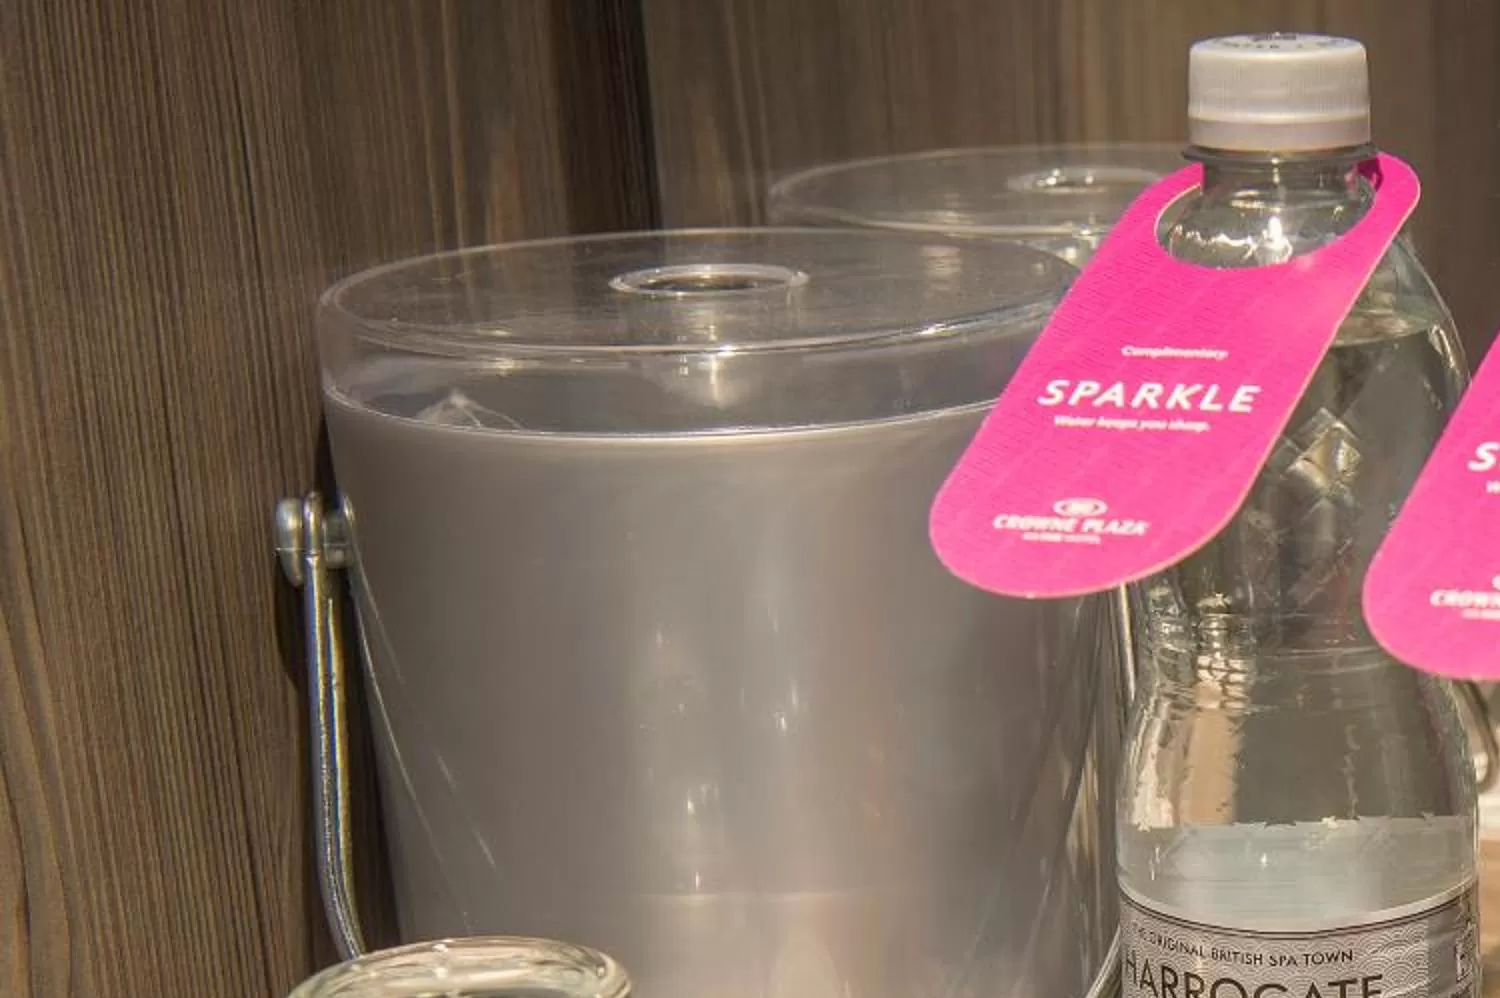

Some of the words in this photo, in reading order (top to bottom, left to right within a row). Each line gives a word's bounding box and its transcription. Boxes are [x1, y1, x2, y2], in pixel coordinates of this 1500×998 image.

[1038, 379, 1260, 413] SPARKLE
[1081, 518, 1149, 536] PLAZA
[1149, 930, 1205, 958] ORIGINAL
[1211, 948, 1264, 966] BRITISH
[1269, 953, 1298, 967] SPA
[1303, 949, 1354, 966] TOWN
